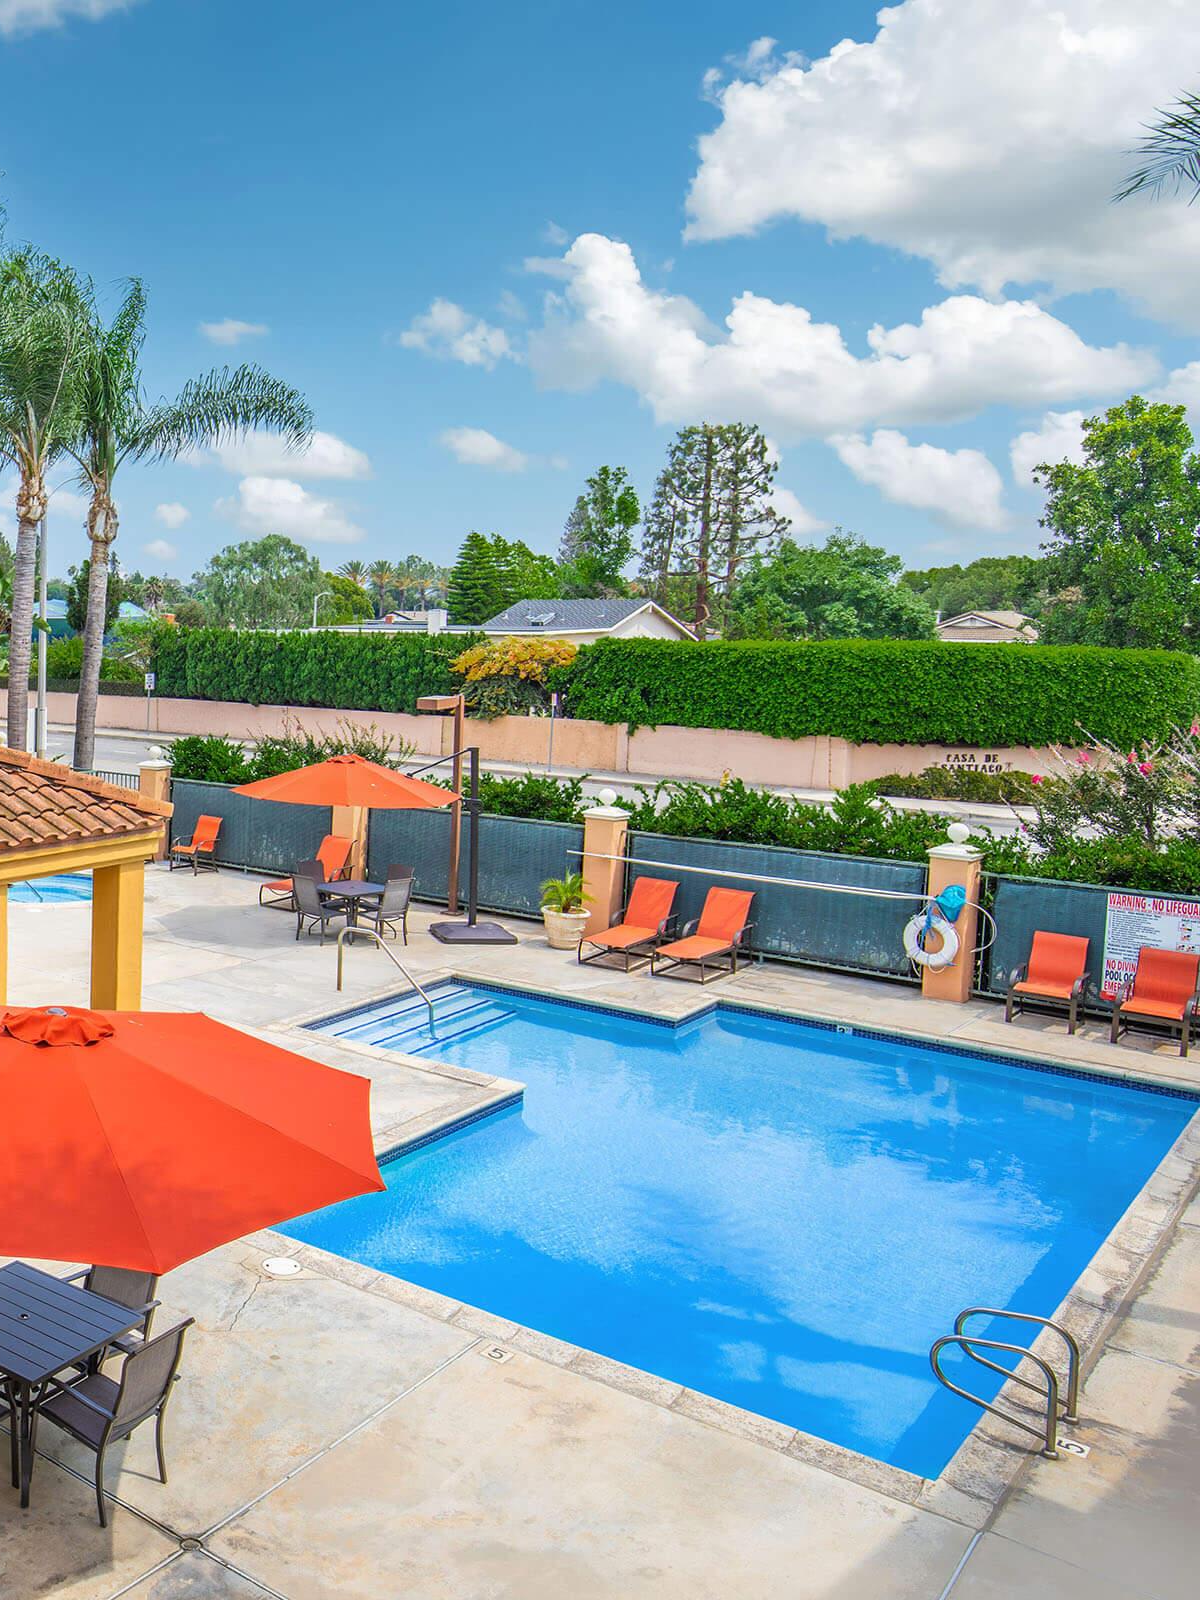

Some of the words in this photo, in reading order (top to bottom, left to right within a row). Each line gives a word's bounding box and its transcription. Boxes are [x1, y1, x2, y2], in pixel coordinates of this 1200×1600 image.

[946, 753, 975, 763] CASA
[984, 753, 999, 763] DE
[1109, 893, 1147, 910] WARNING
[1151, 898, 1165, 912] NO
[1166, 900, 1200, 916] LIFEGUA
[1106, 960, 1116, 971] NO
[1117, 961, 1137, 973] DIVIN
[1105, 970, 1122, 982] POOL
[488, 1348, 508, 1359] 5
[1057, 1440, 1085, 1453] 5
